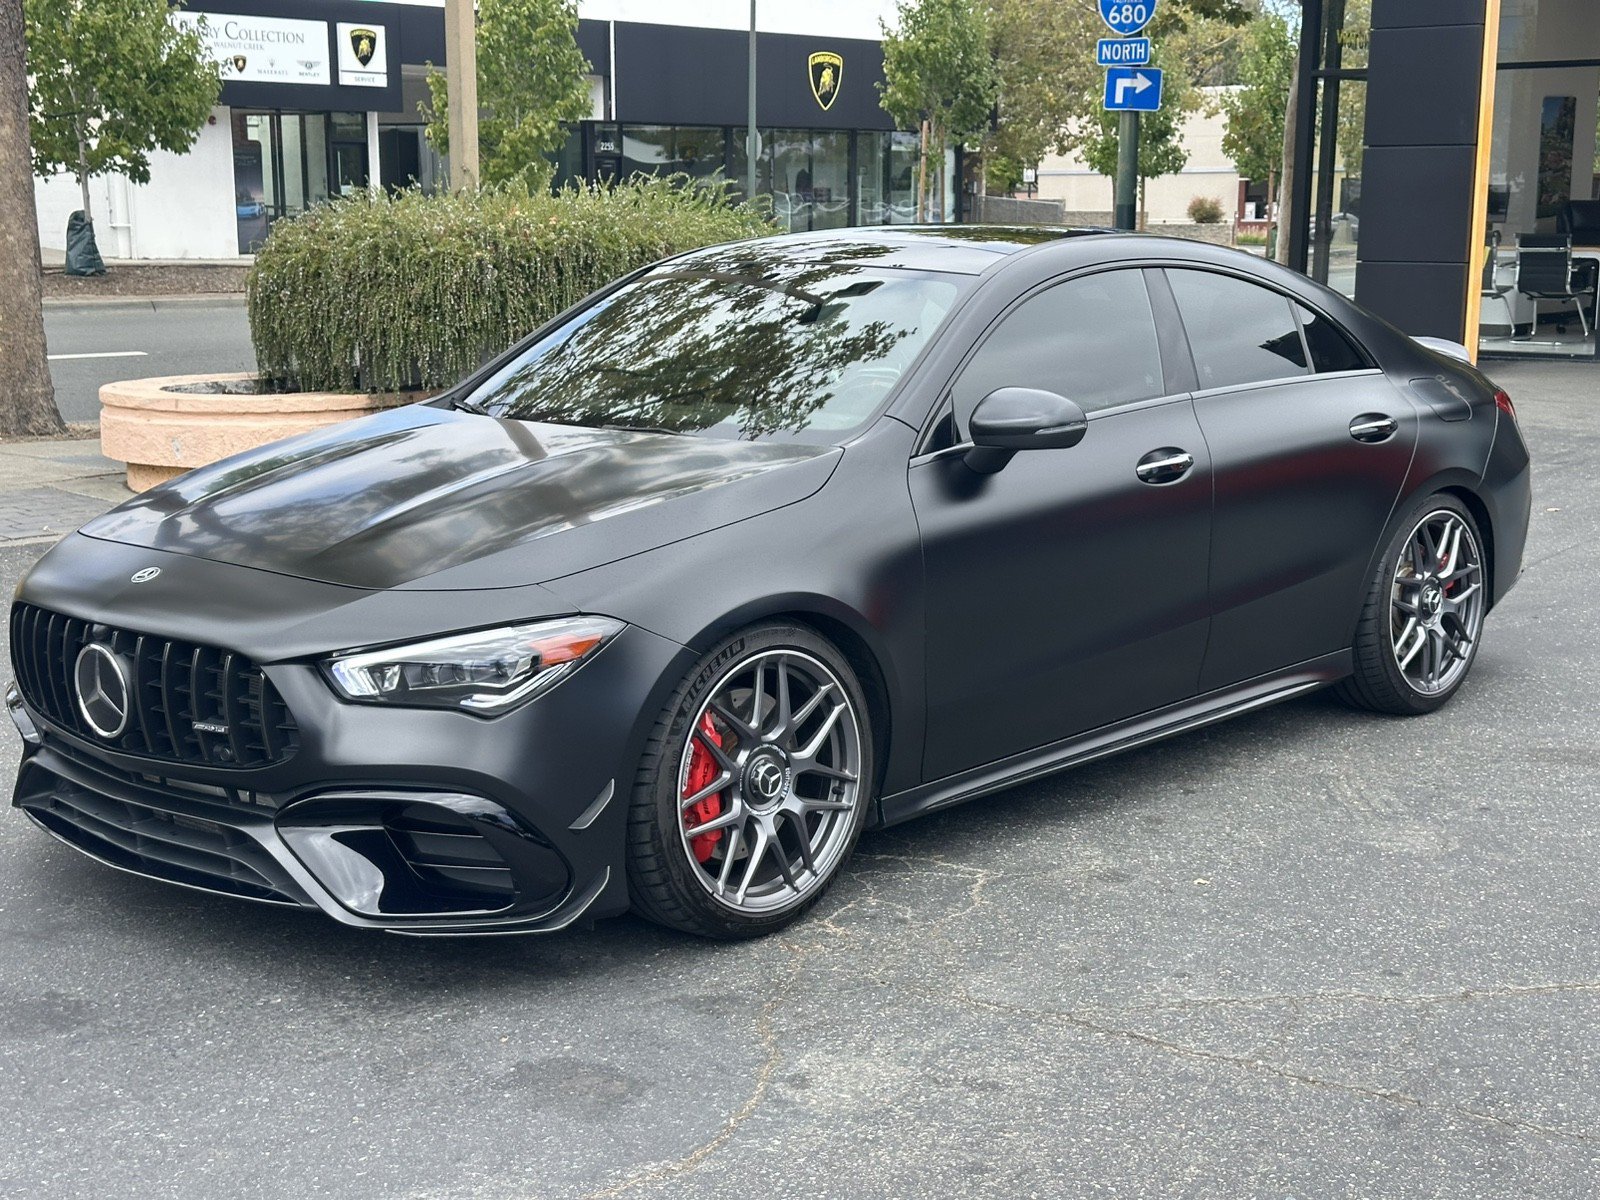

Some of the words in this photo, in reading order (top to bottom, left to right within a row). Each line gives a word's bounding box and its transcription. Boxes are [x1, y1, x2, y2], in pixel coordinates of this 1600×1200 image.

[1108, 4, 1147, 24] 680
[225, 21, 304, 43] COLLECTION
[213, 41, 242, 49] WALNUT
[243, 43, 265, 51] CREEK
[1101, 43, 1146, 60] NORTH
[600, 141, 615, 151] 2255
[681, 638, 743, 714] MICHELIN
